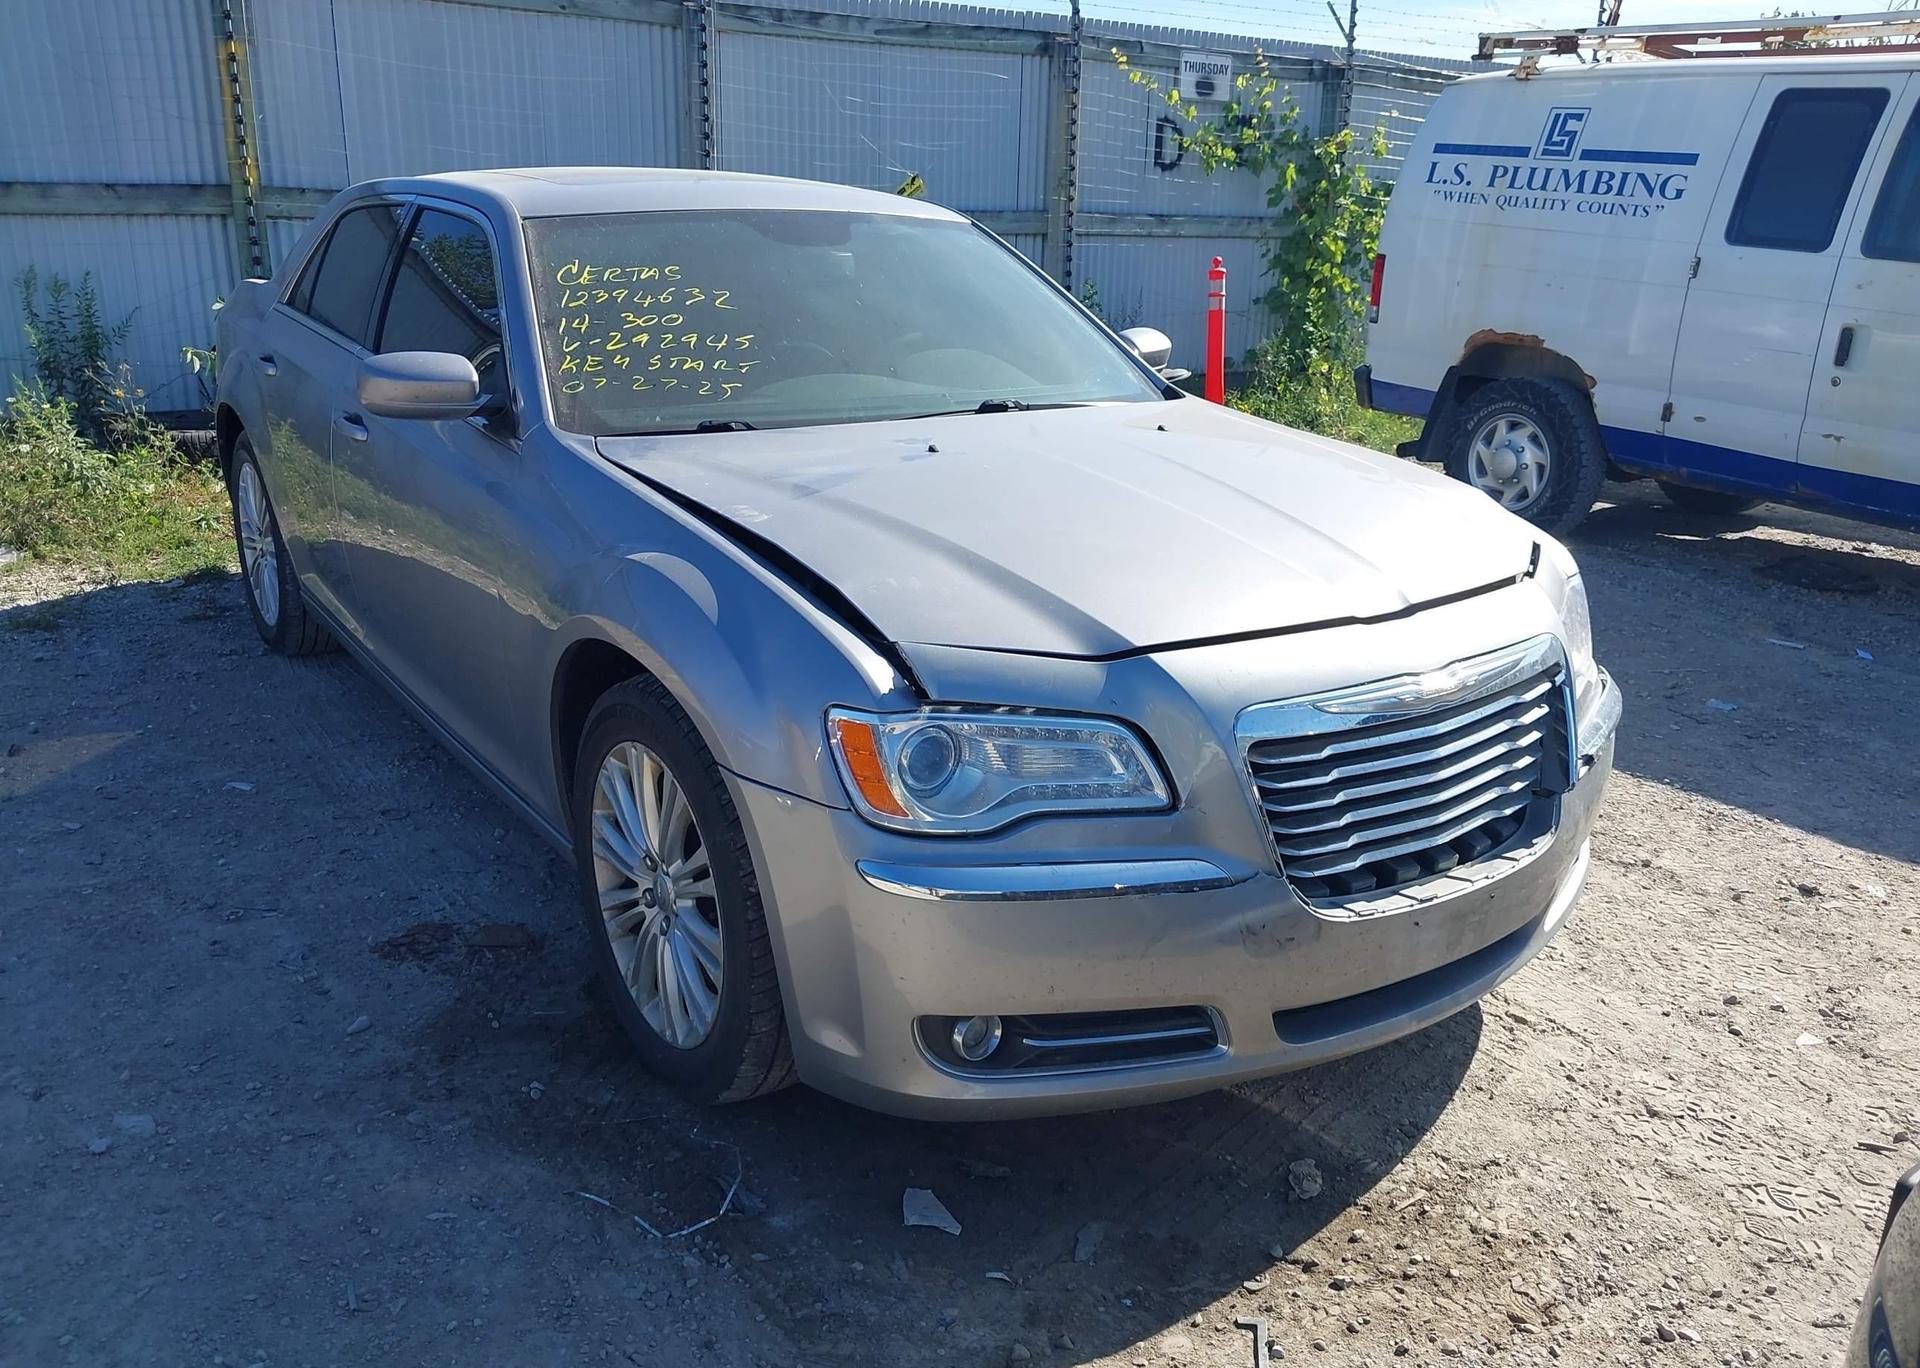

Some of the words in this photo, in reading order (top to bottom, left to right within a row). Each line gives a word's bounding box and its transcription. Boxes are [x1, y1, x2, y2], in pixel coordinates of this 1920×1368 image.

[1183, 60, 1229, 76] THURSDAY
[1425, 161, 1473, 188] L.S.
[1487, 165, 1689, 201] PLUMBING
[1495, 195, 1571, 212] QUALITY
[621, 312, 684, 328] 300
[648, 355, 760, 373] START
